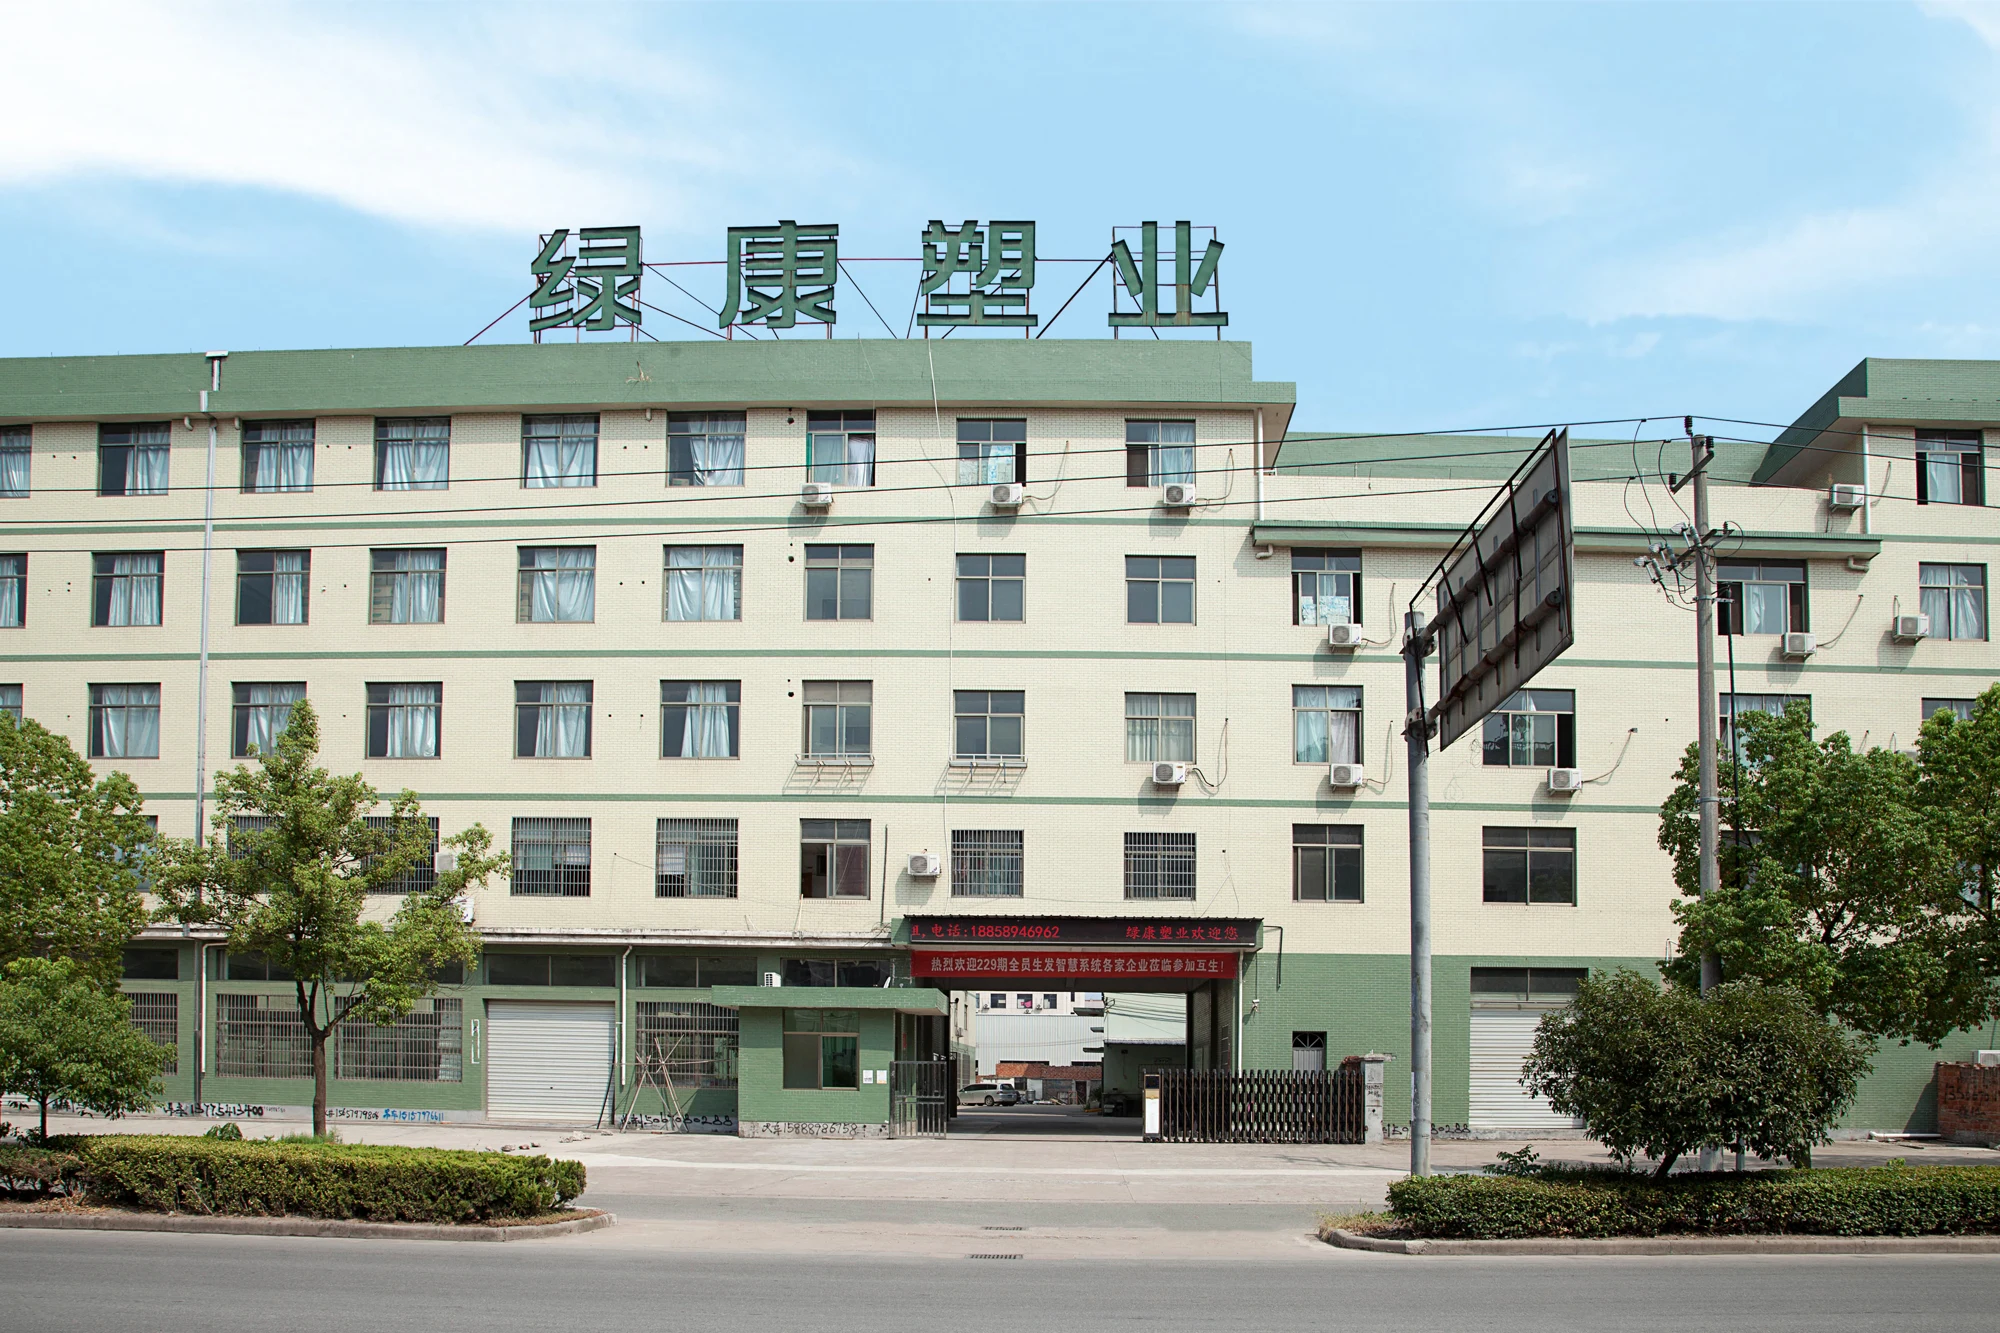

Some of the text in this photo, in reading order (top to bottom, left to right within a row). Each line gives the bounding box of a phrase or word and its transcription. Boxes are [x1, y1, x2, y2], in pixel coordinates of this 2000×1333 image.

[529, 220, 1229, 331] 绿康塑业
[1125, 925, 1239, 941] 绿康塑业欢迎您
